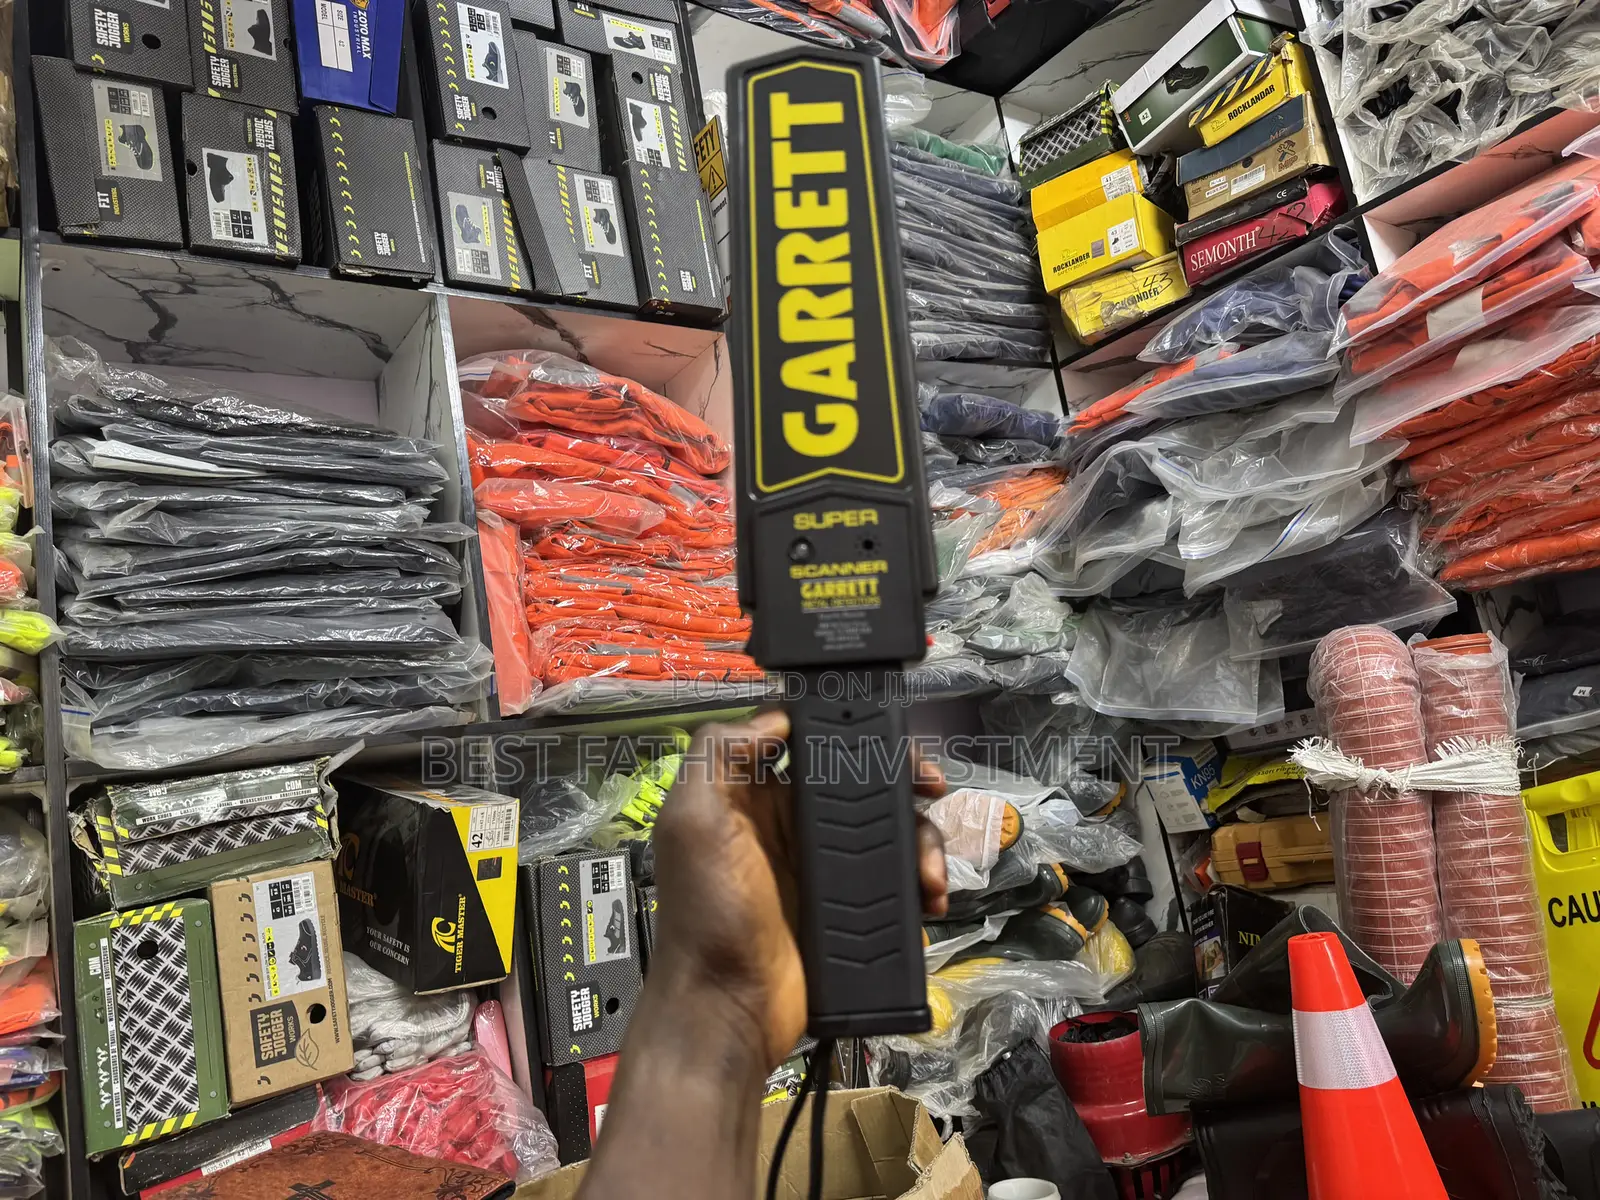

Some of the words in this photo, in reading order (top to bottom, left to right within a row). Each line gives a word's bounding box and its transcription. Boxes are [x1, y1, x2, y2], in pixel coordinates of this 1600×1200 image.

[94, 8, 109, 46] SAFETY
[107, 11, 121, 49] JOGGER
[122, 22, 131, 44] WORKS
[353, 11, 361, 53] INDUSTRIAL
[209, 55, 222, 86] SAFETY
[220, 57, 232, 89] JOGGER
[655, 72, 665, 101] JOGGER
[661, 73, 672, 104] SAFETY
[454, 94, 465, 120] SAFETY
[462, 95, 472, 121] JOGGER
[1227, 84, 1275, 121] ROCKLANDAR
[254, 117, 265, 148] JOGGER
[264, 119, 275, 150] SAFETY
[486, 170, 495, 186] FIT
[493, 165, 505, 194] SMART
[97, 191, 110, 209] FIT
[374, 231, 385, 256] SAFETY
[381, 232, 391, 256] JOGGER
[1190, 230, 1257, 272] SEMONTH
[583, 263, 593, 279] FIT
[769, 92, 859, 458] GARRETT
[1053, 251, 1091, 274] ROCKLANDER
[1143, 272, 1173, 294] 43
[793, 508, 879, 530] SUPER
[789, 559, 888, 580] SCANNER
[801, 577, 879, 599] GARRETT
[1190, 763, 1216, 790] KN95
[141, 815, 156, 824] WORK
[471, 832, 483, 848] 42
[458, 895, 467, 941] MASTER
[366, 926, 382, 940] YOUR
[382, 933, 403, 950] SAFETY
[404, 944, 411, 953] IS
[369, 940, 382, 950] OUR
[382, 943, 410, 966] CONCERN
[88, 956, 102, 979] .COM
[455, 943, 464, 974] TIGER
[570, 990, 583, 1032] SAFETY
[580, 987, 593, 1030] JOGGER
[592, 994, 600, 1018] WORKS
[256, 1012, 272, 1061] SAFETY
[270, 1008, 287, 1057] JOGGER
[287, 1015, 296, 1043] WORKS
